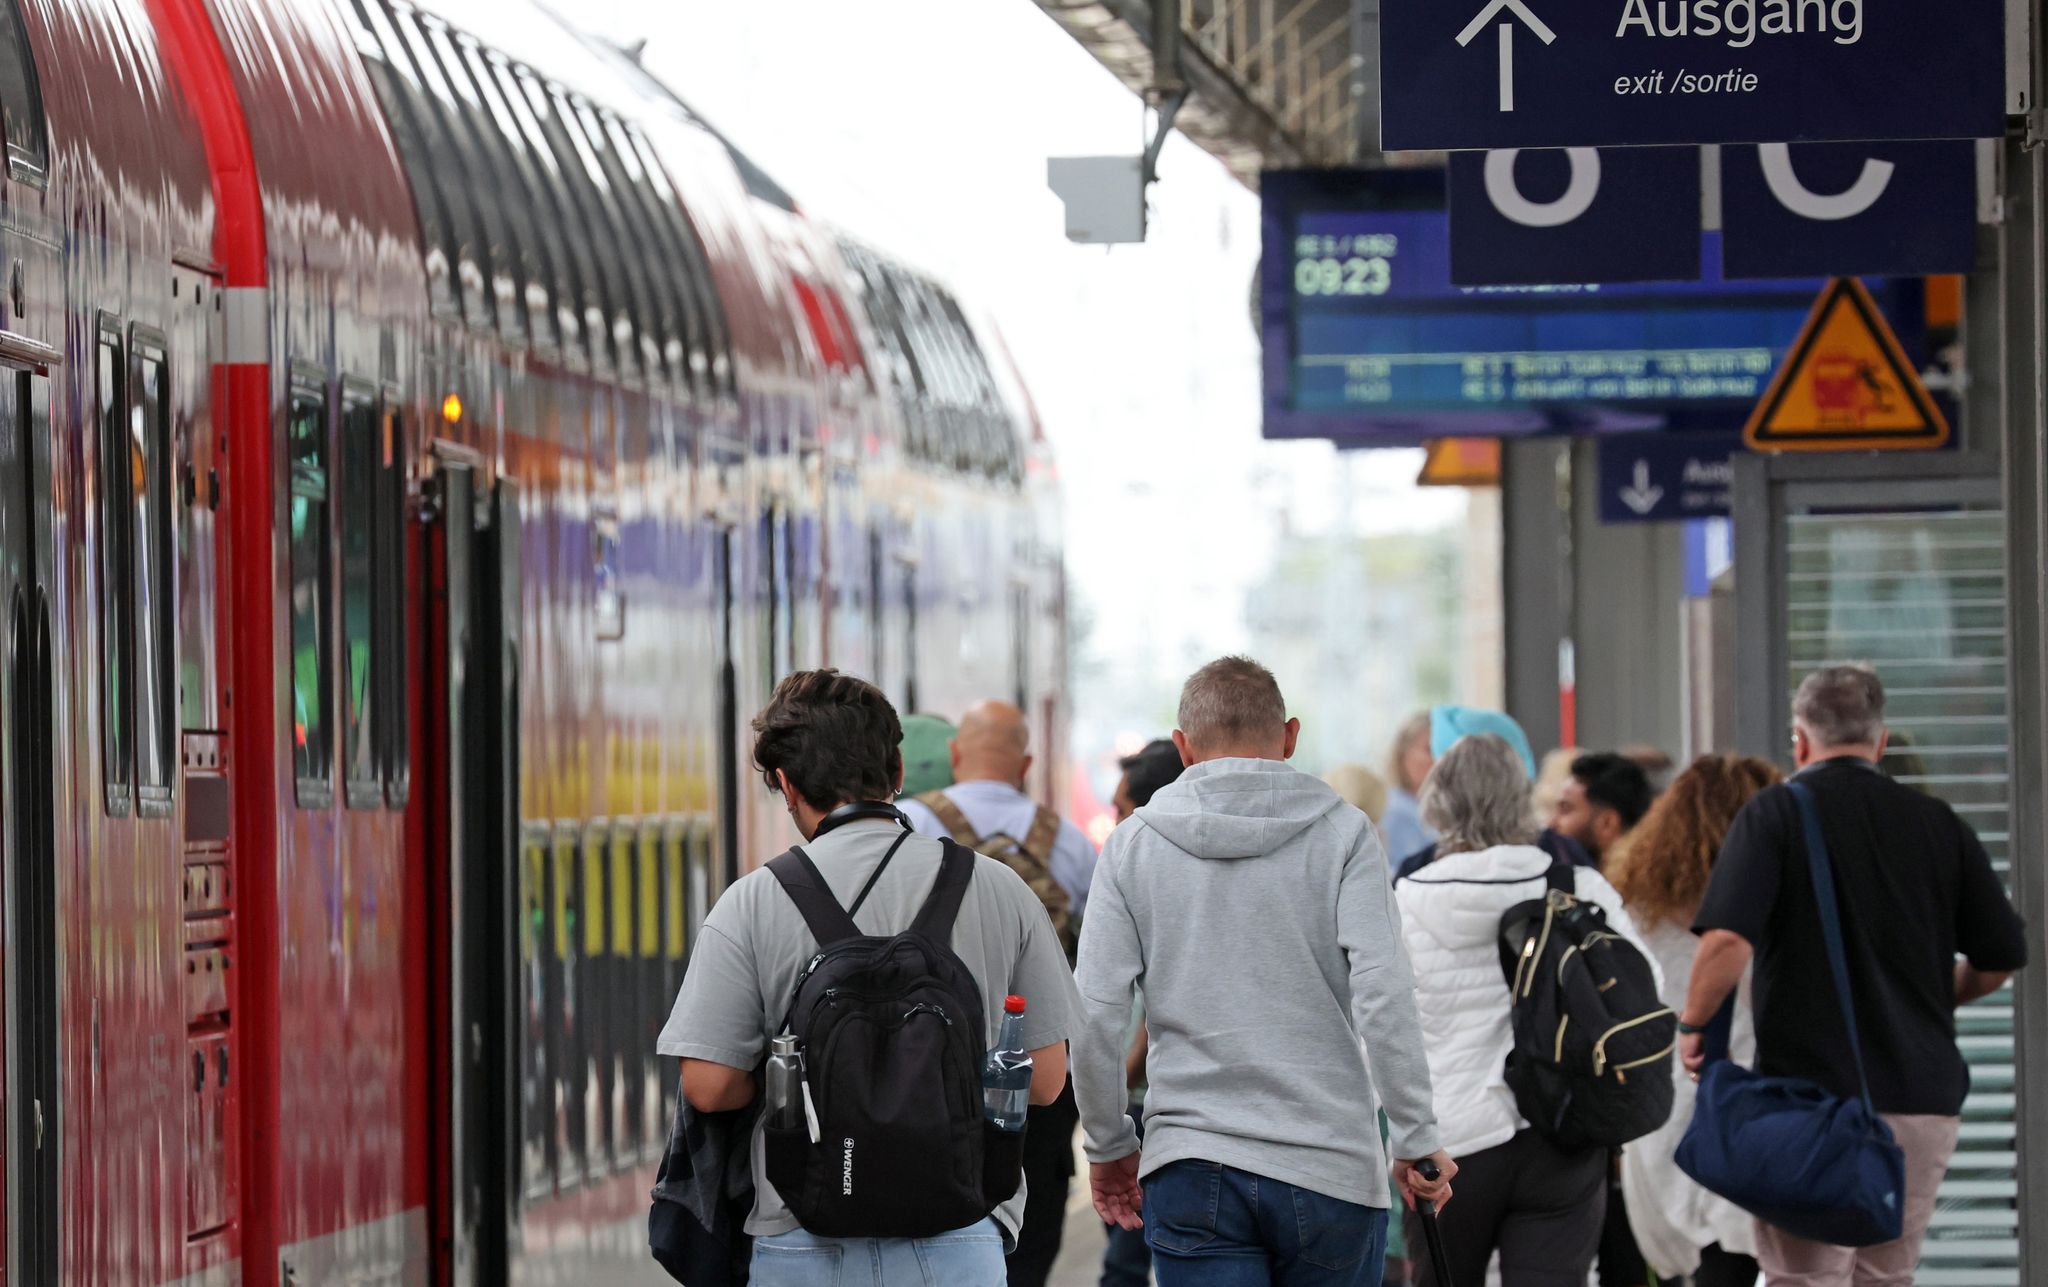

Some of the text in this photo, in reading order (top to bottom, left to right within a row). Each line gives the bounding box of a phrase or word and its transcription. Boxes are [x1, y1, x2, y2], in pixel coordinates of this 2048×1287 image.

[1615, 0, 1864, 48] Ausgang
[1614, 69, 1664, 95] exit
[843, 1149, 852, 1195] WENGER
